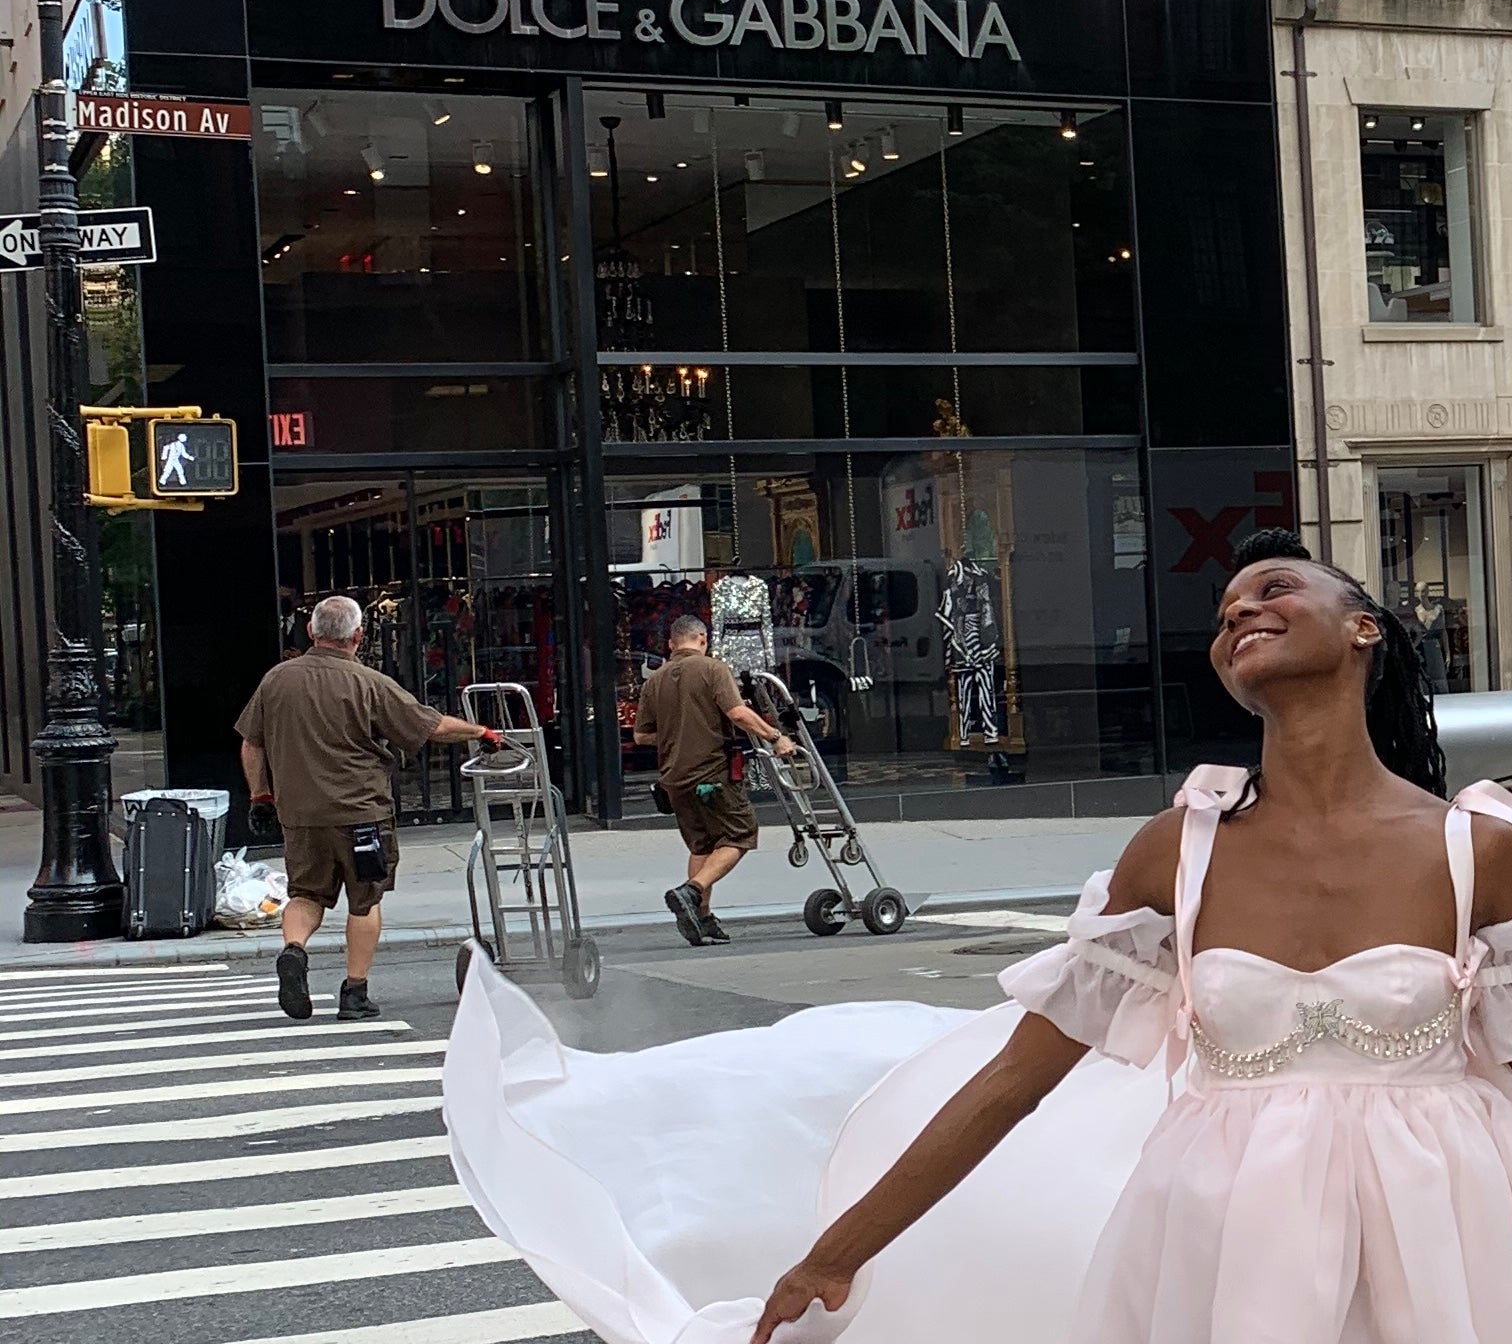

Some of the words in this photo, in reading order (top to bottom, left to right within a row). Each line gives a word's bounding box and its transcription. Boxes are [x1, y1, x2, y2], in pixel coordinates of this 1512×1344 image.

[634, 8, 664, 44] &
[78, 101, 187, 132] Madison
[200, 107, 230, 134] Av
[3, 232, 37, 253] ON
[78, 226, 128, 248] WAY
